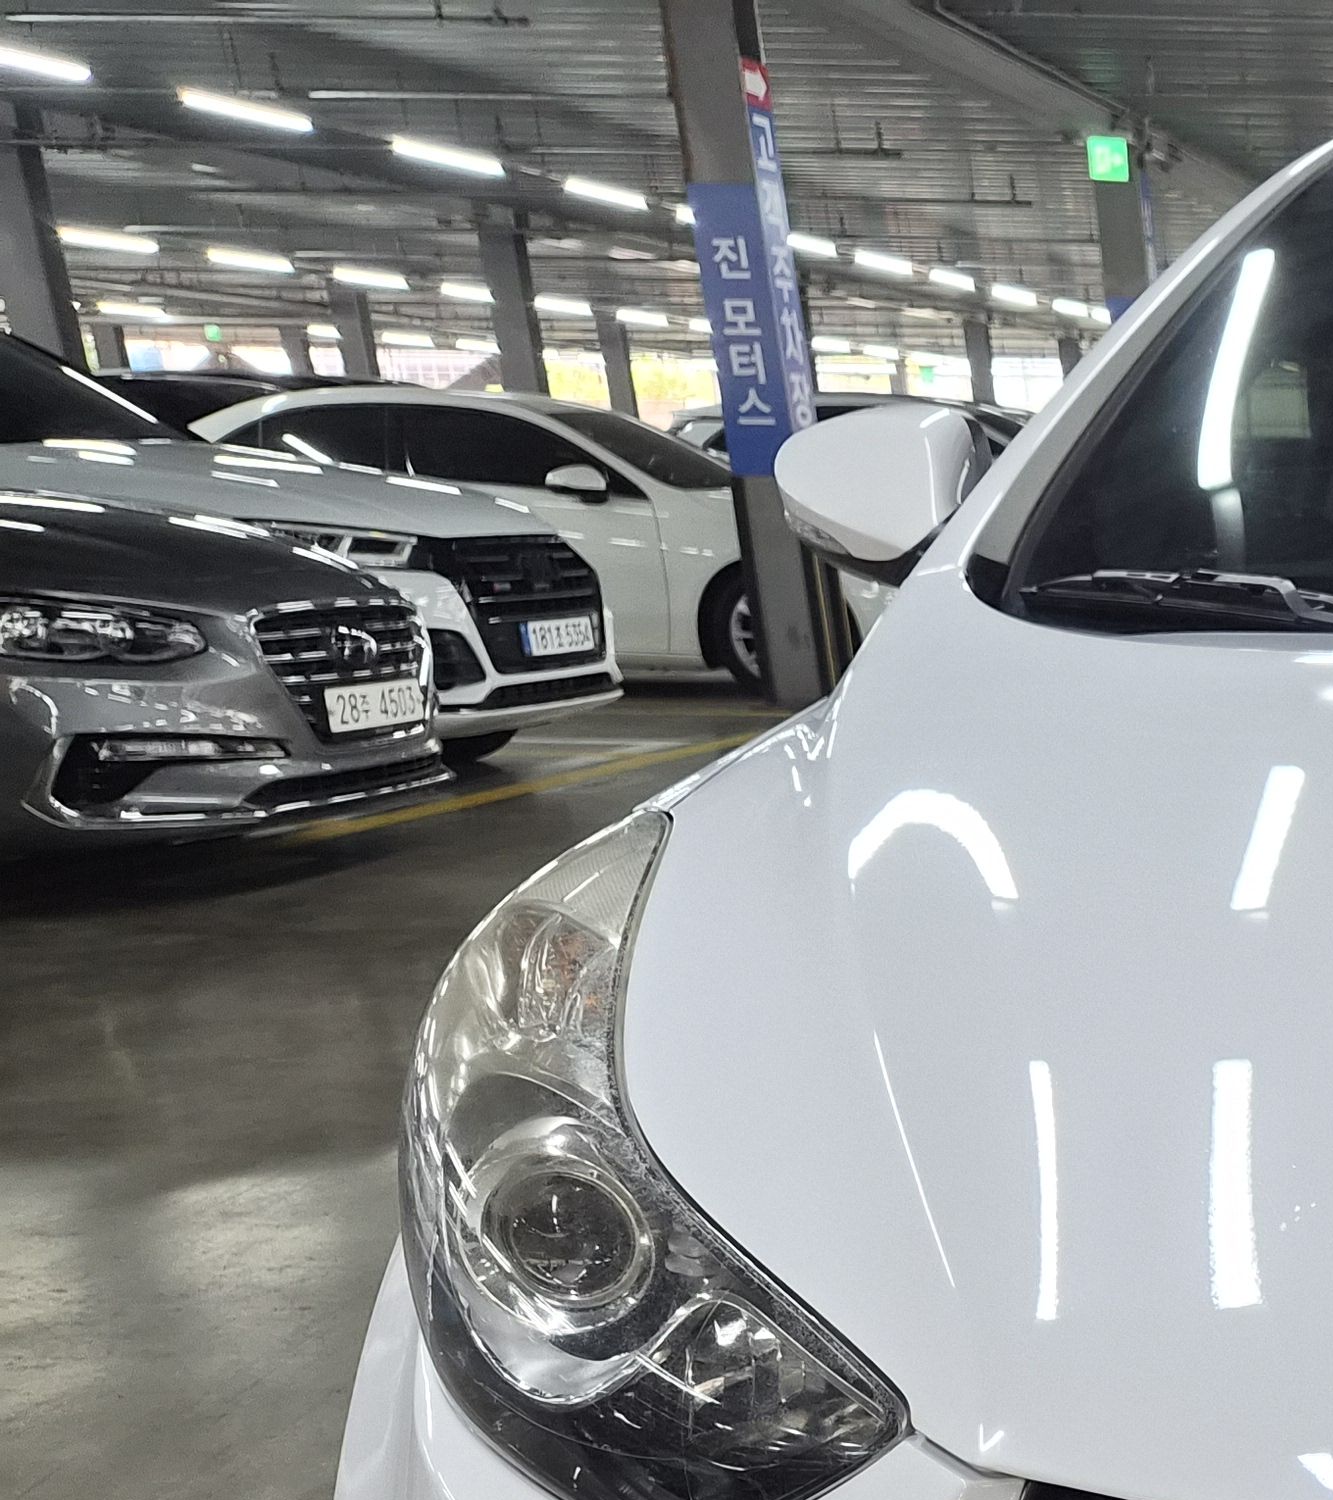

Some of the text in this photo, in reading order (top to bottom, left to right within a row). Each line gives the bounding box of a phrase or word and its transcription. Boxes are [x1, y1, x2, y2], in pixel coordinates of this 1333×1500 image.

[711, 235, 777, 426] 진 모터스
[336, 685, 416, 725] 28주 4503
